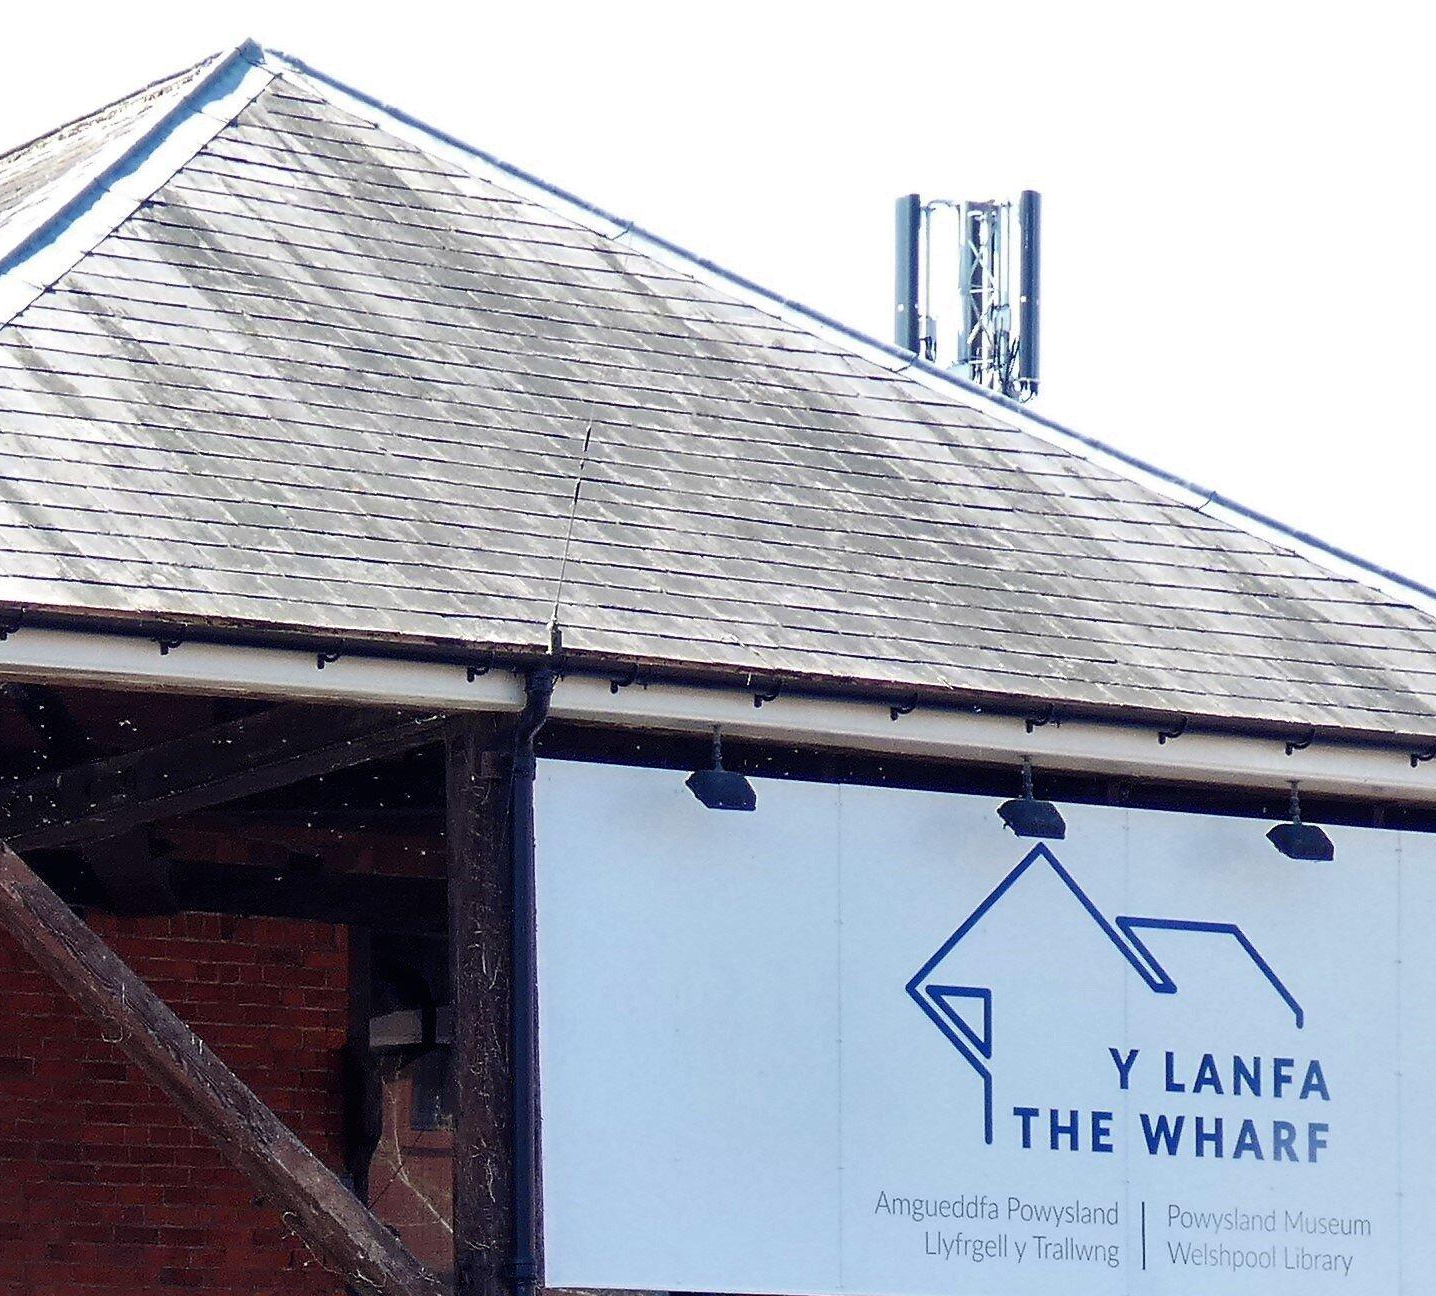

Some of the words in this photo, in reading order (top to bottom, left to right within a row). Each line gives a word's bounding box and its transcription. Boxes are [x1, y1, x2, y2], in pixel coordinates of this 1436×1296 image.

[1109, 1047, 1140, 1091] Y
[1165, 1051, 1332, 1102] LANFA
[1012, 1106, 1114, 1153] THE
[1139, 1113, 1331, 1164] WHARF
[874, 1190, 1000, 1223] Amgueddfa
[1006, 1197, 1120, 1229] Powysland
[1167, 1203, 1277, 1237] Powysland
[1283, 1209, 1373, 1236] Museum
[924, 1231, 1010, 1263] Llyfrgell
[1013, 1240, 1027, 1263] y
[1032, 1235, 1120, 1268] Trallwng
[1167, 1240, 1277, 1274] Welshpool
[1284, 1245, 1354, 1277] Library
